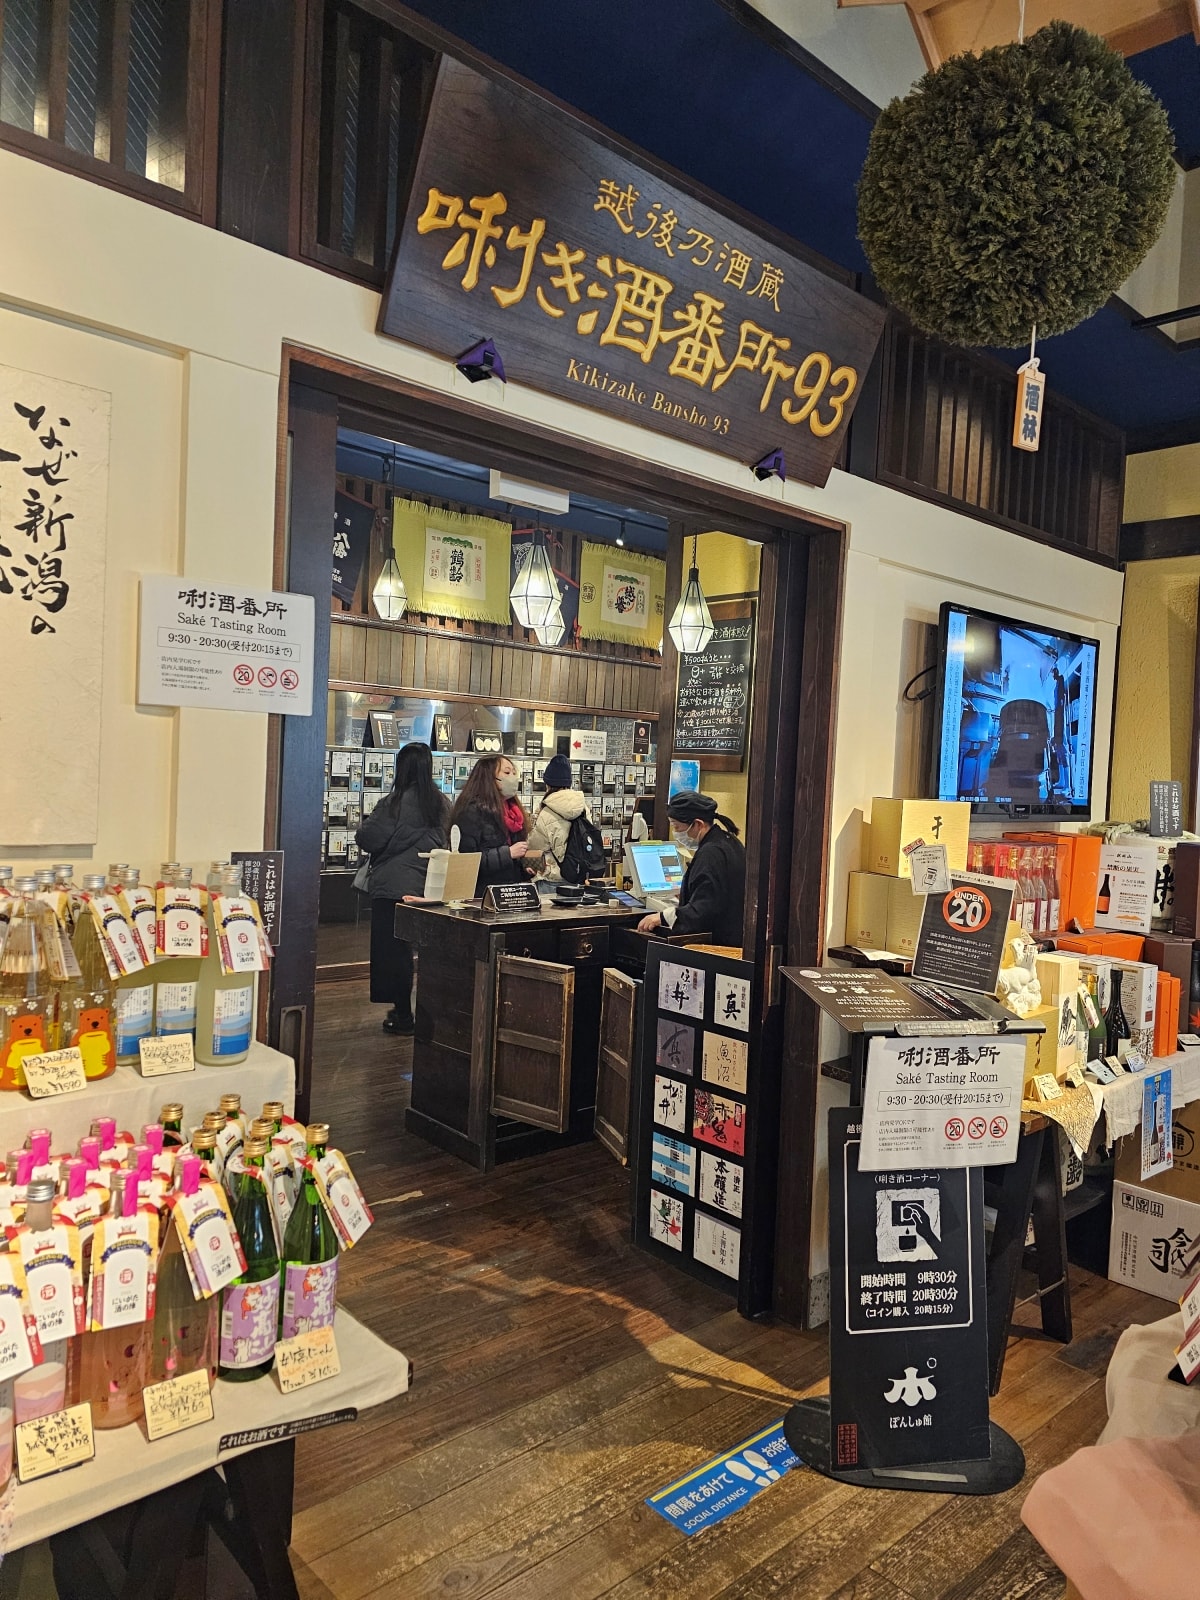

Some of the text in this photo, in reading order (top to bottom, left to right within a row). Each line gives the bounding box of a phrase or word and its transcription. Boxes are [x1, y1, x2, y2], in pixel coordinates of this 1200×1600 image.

[593, 179, 787, 312] 越後乃酒蔵
[565, 359, 731, 436] Kikizake Bansho 93
[177, 612, 287, 637] Saké Tasting Room
[168, 632, 191, 644] 9:30
[237, 670, 250, 682] 20
[263, 859, 277, 935] これはお酒です
[954, 891, 985, 904] UNDER
[948, 898, 983, 928] 20
[722, 989, 741, 1021] 真
[896, 1071, 998, 1086] Saké Tasting Room
[886, 1095, 907, 1106] 9:30
[949, 1124, 961, 1136] 20
[860, 1270, 958, 1289] 開始時間 9時30分
[860, 1287, 959, 1306] 終了時間 20時30分
[889, 1413, 933, 1429] ぽんしゅ館
[219, 1424, 288, 1450] これはお酒です
[663, 1472, 735, 1519] 間隔をあけて
[684, 1486, 749, 1530] SOCIAL DISTANCE
